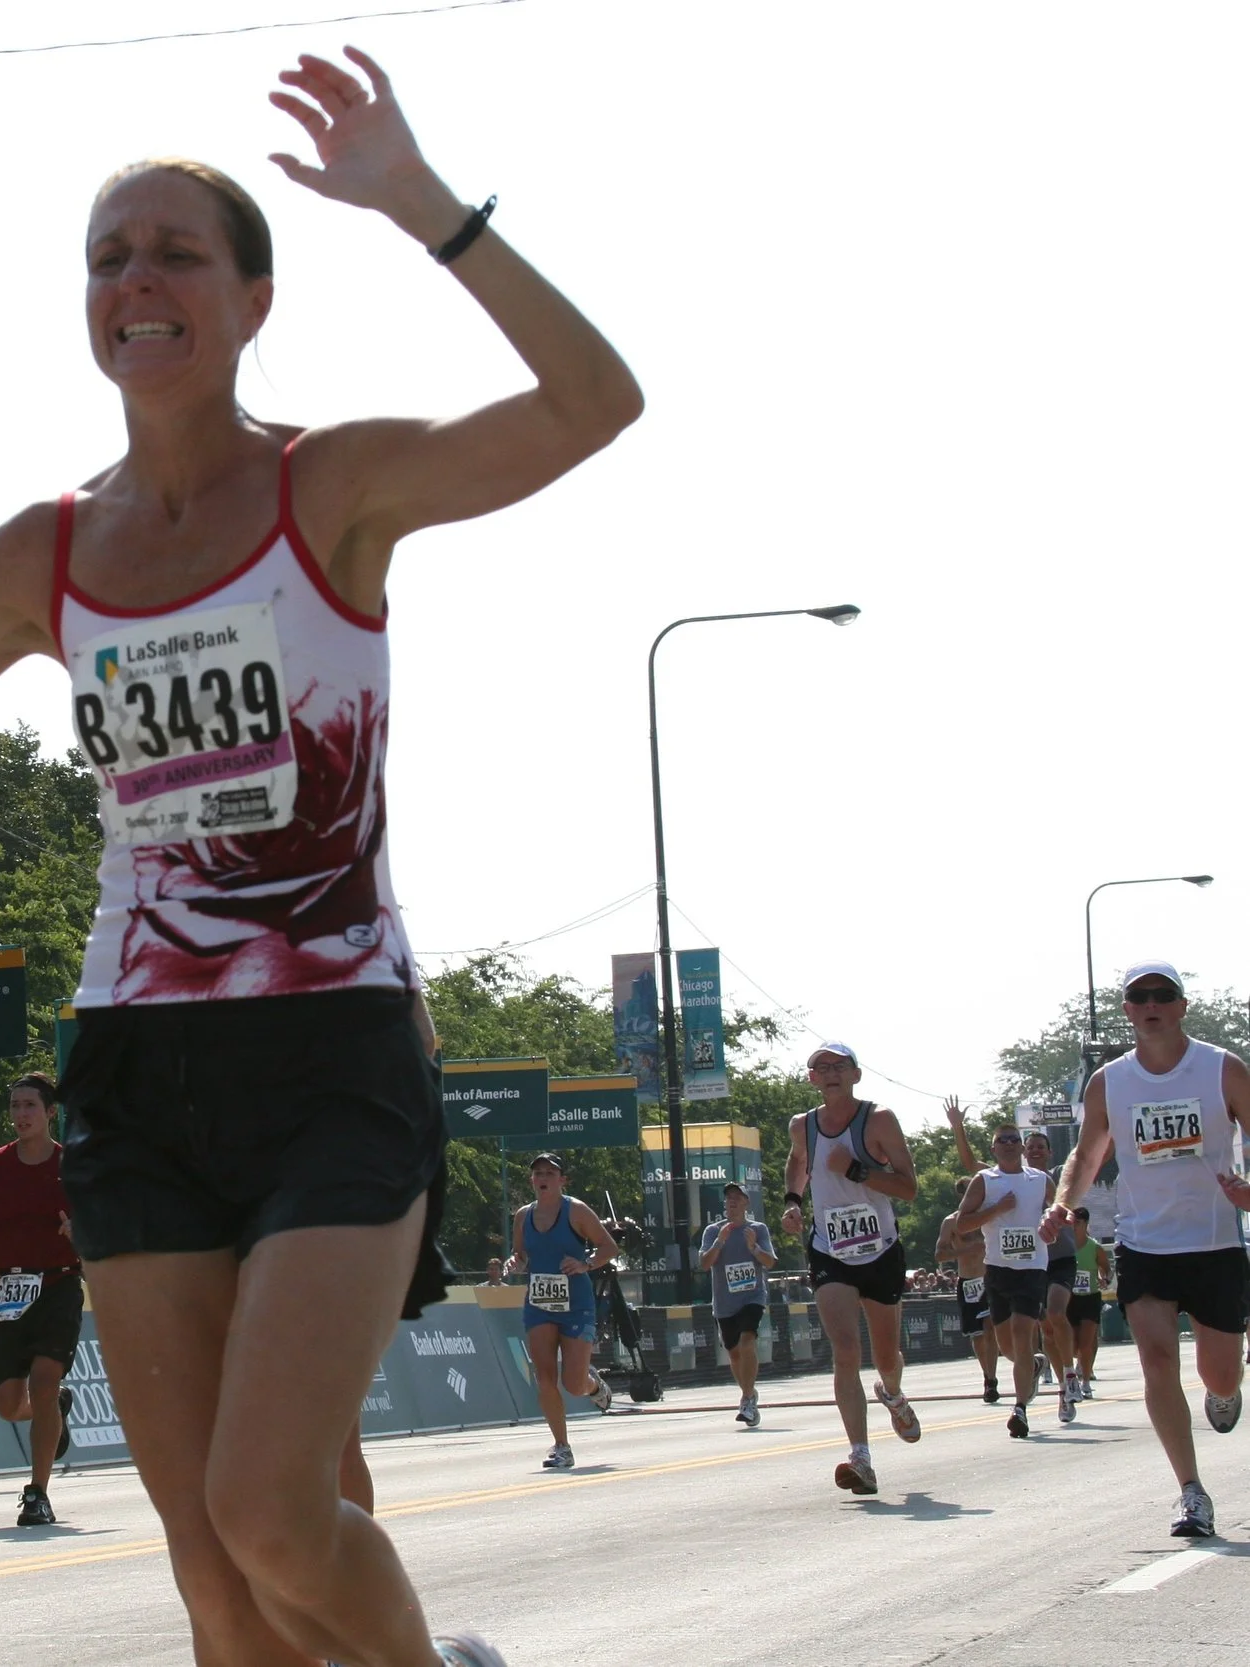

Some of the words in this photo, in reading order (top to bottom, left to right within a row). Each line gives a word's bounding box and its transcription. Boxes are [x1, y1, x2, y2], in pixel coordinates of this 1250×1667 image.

[126, 639, 189, 662] LaSalle
[193, 625, 239, 650] Bank
[75, 693, 119, 766] B
[125, 661, 282, 758] 3439
[165, 748, 277, 786] ANNIVERSARY
[442, 1089, 462, 1101] ank
[463, 1088, 475, 1100] of
[475, 1087, 520, 1100] America
[592, 1106, 622, 1120] Bank
[563, 1123, 584, 1132] AMRO
[1135, 1118, 1146, 1142] A
[1152, 1113, 1200, 1140] 1578
[692, 1166, 726, 1180] Bank
[827, 1223, 836, 1241] B
[841, 1216, 879, 1238] 4740
[1002, 1235, 1033, 1248] 33769
[727, 1272, 733, 1282] C
[734, 1268, 755, 1281] 5392
[4, 1284, 39, 1302] 5370
[532, 1283, 567, 1298] 15495
[410, 1331, 436, 1355] Bank
[433, 1330, 444, 1355] of
[439, 1330, 476, 1355] America
